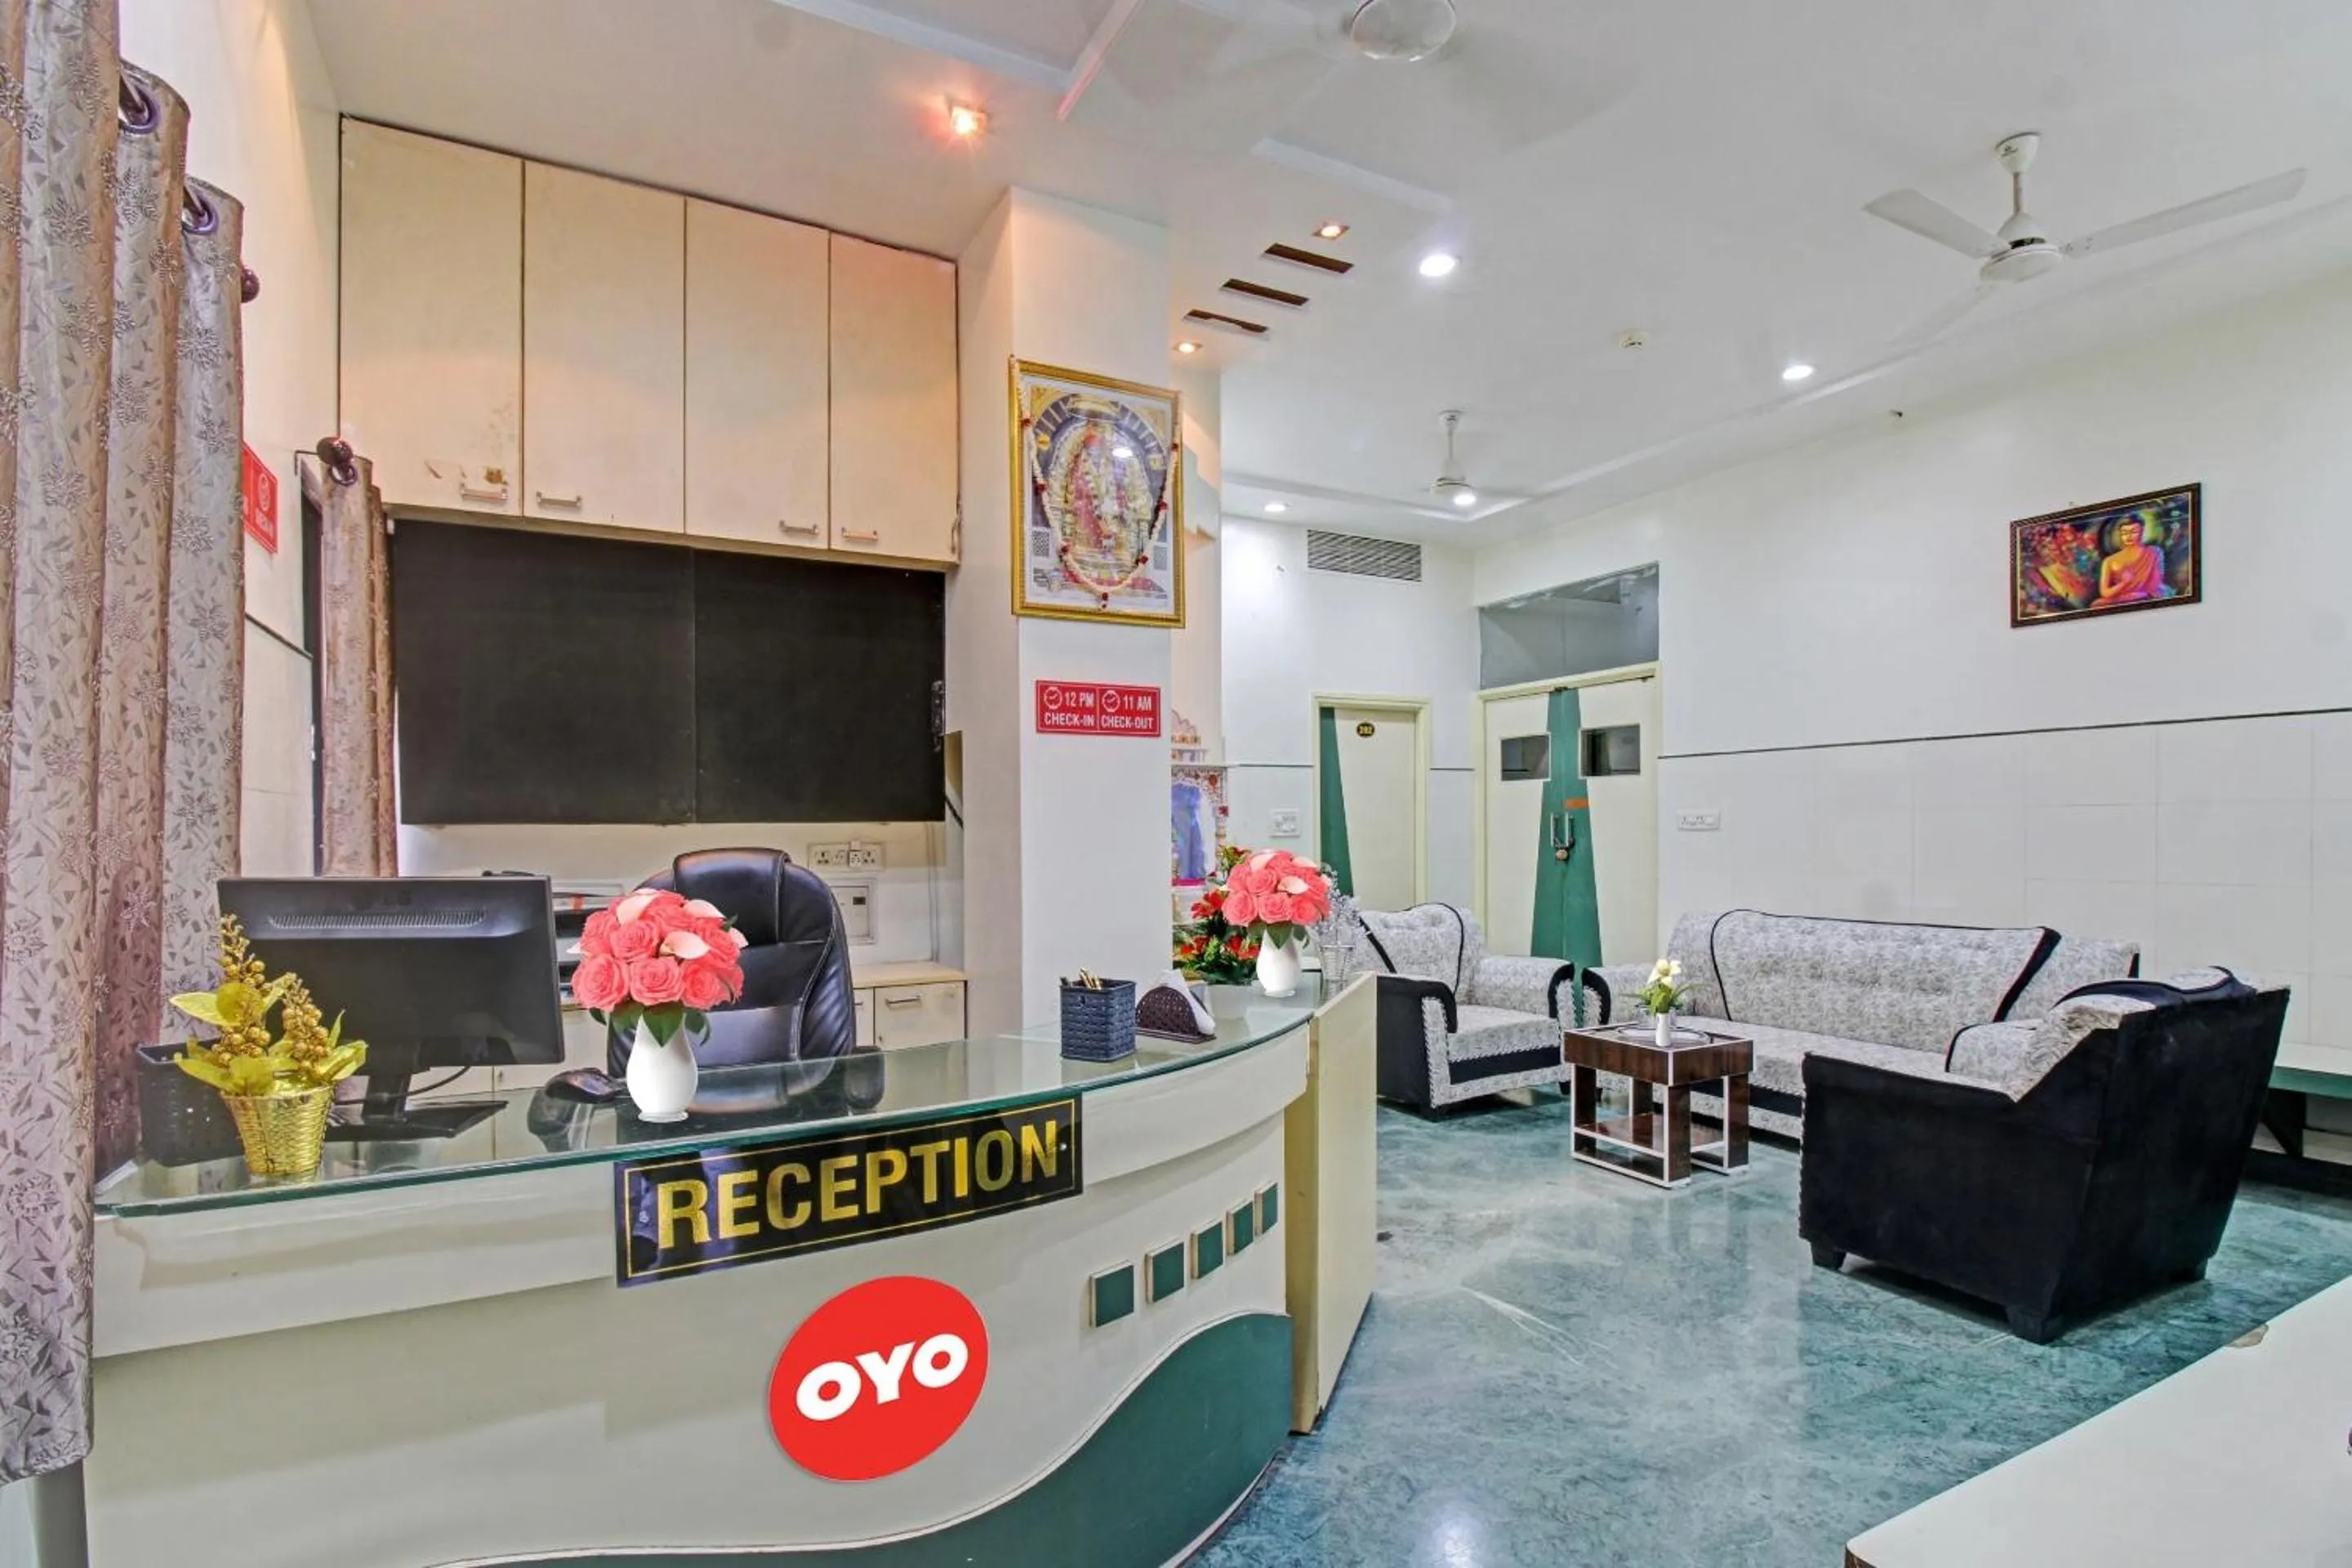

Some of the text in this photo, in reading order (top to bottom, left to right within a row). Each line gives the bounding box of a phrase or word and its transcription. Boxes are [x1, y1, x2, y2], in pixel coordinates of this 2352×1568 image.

[1065, 692, 1094, 707] 12 PM
[1123, 695, 1152, 710] 11 AM
[1044, 712, 1094, 726] CHECK-IN
[1101, 715, 1154, 729] CHECK-OUT
[657, 1120, 1058, 1250] RECEPTION
[795, 1333, 969, 1421] OYO
